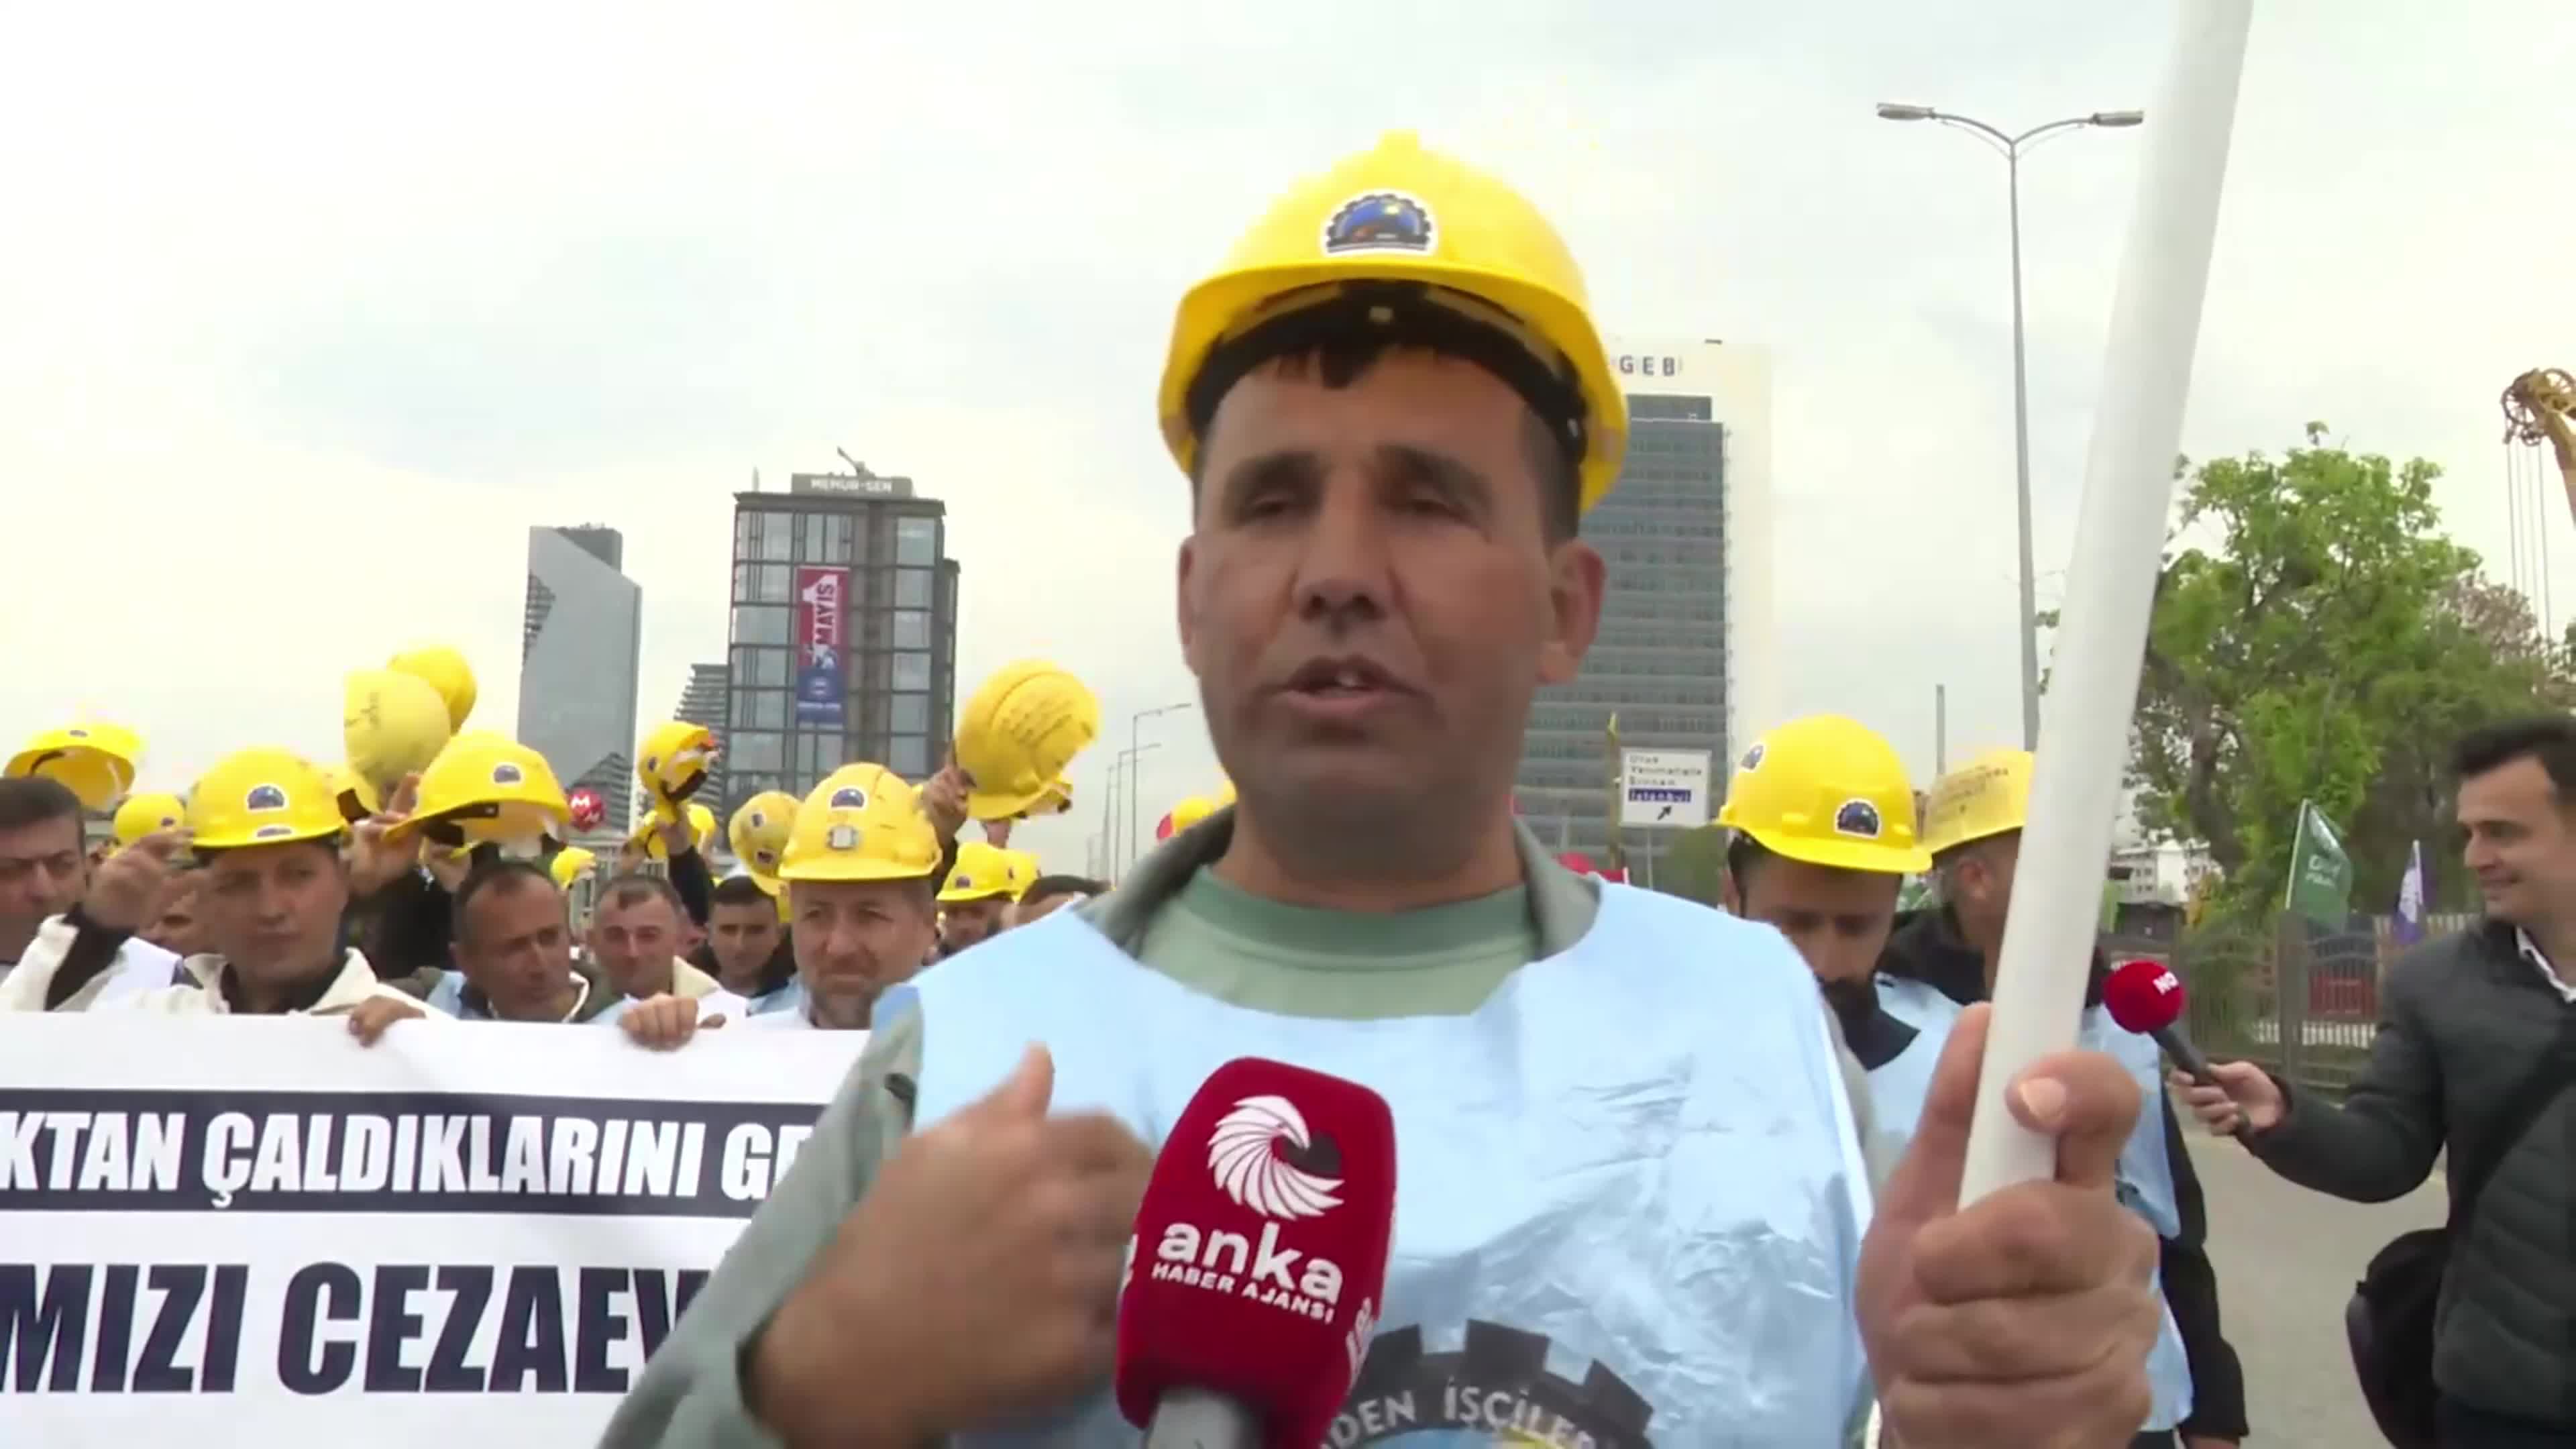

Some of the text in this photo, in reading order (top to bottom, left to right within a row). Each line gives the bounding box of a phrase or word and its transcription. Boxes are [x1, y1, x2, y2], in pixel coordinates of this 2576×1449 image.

[816, 583, 835, 645] MAYIS
[0, 1111, 186, 1191] KTAN
[203, 1112, 706, 1208] ÇALDIKLARINI
[1151, 1262, 1236, 1294] HABER
[1242, 1281, 1335, 1324] AJANSI
[1157, 1221, 1343, 1305] anka
[0, 1264, 250, 1393] MIZI
[1320, 1389, 1417, 1449] DEN
